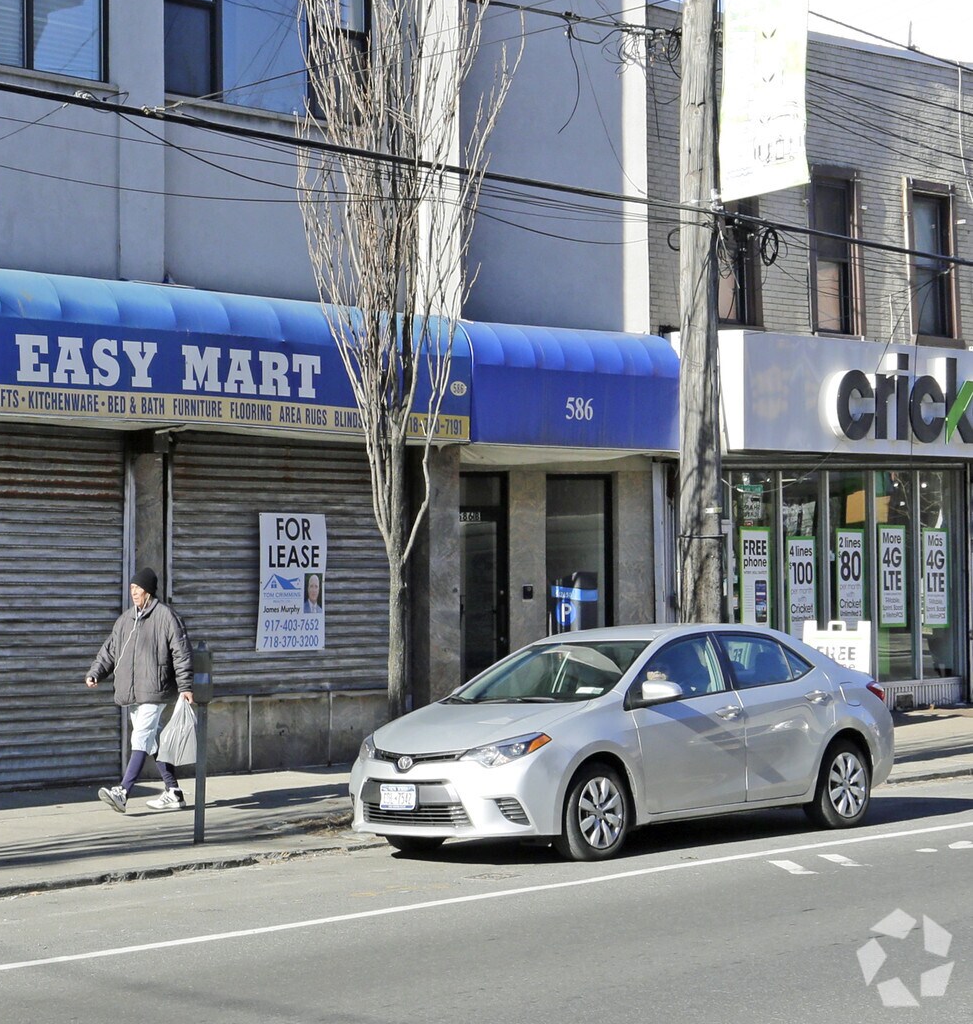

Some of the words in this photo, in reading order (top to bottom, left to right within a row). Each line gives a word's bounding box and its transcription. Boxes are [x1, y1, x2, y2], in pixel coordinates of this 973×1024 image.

[15, 333, 158, 388] EASY
[182, 344, 322, 399] MART
[28, 390, 100, 413] KITCHENWARE
[108, 395, 126, 414] BED
[129, 396, 137, 414] &
[141, 397, 165, 415] BATH
[173, 398, 222, 418] FURNITURE
[230, 401, 272, 422] FLOORING
[279, 405, 302, 424] AREA
[305, 407, 327, 426] RUGS
[566, 397, 593, 420] 586
[276, 518, 312, 541] FOR
[882, 532, 901, 544] More
[743, 540, 767, 556] FREE
[839, 537, 844, 548] 2
[844, 537, 861, 548] lines
[928, 534, 943, 547] Más
[269, 545, 319, 568] LEASE
[789, 546, 794, 556] 4
[795, 546, 813, 557] lines
[882, 547, 902, 568] 4G
[926, 550, 945, 570] 4G
[743, 556, 767, 569] phone
[838, 550, 862, 581] $80
[789, 561, 813, 585] $100
[883, 571, 902, 591] LTE
[927, 572, 945, 592] LTE
[263, 606, 279, 614] James
[280, 605, 300, 615] Murphy
[791, 603, 814, 614] Cricket
[839, 598, 862, 609] Cricket
[265, 619, 319, 632] 917-403-7652
[263, 635, 319, 648] 718-370-3200
